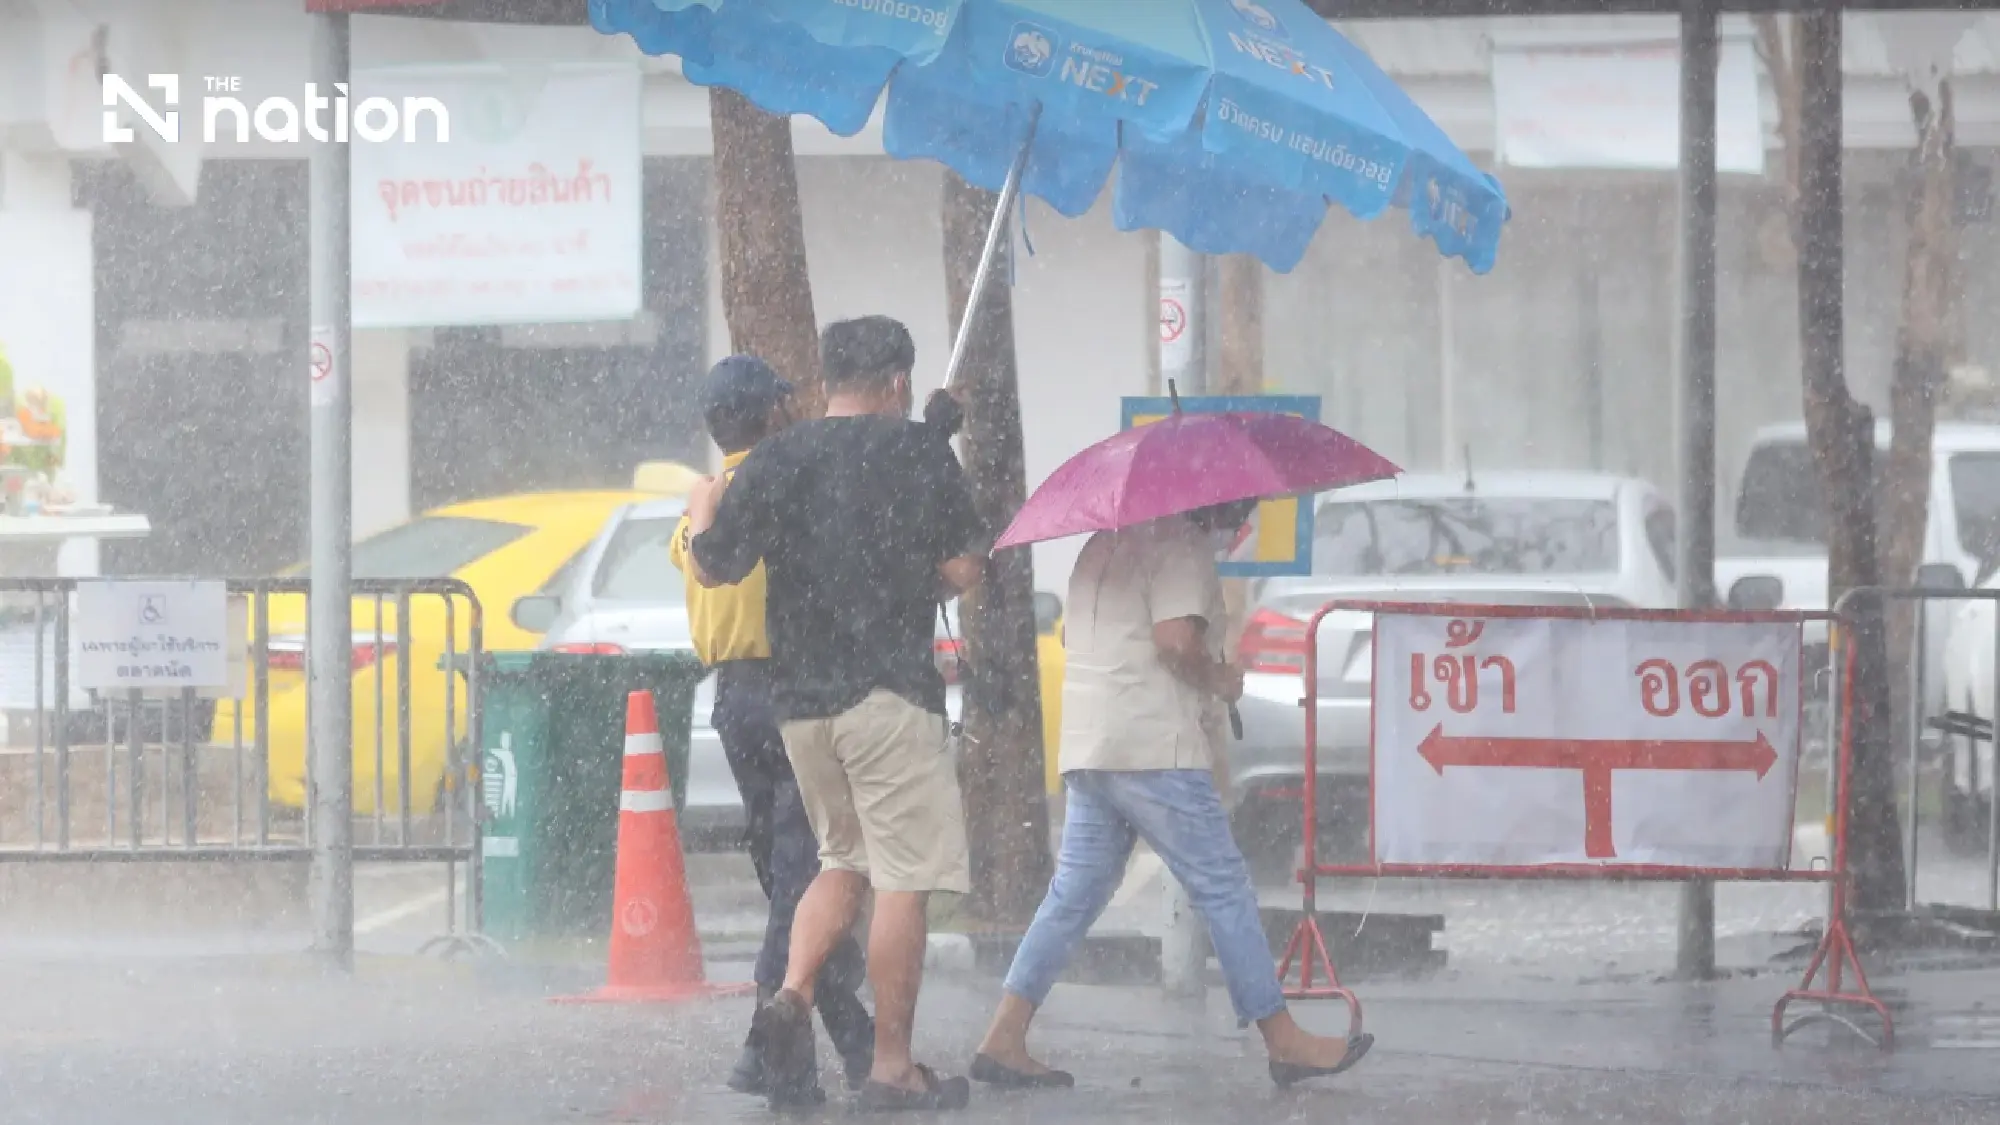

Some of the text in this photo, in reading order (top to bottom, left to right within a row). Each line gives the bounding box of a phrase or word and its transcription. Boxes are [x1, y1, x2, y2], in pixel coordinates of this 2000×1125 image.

[1060, 56, 1159, 106] NEXT
[1408, 619, 1778, 719] เข้า ออก
